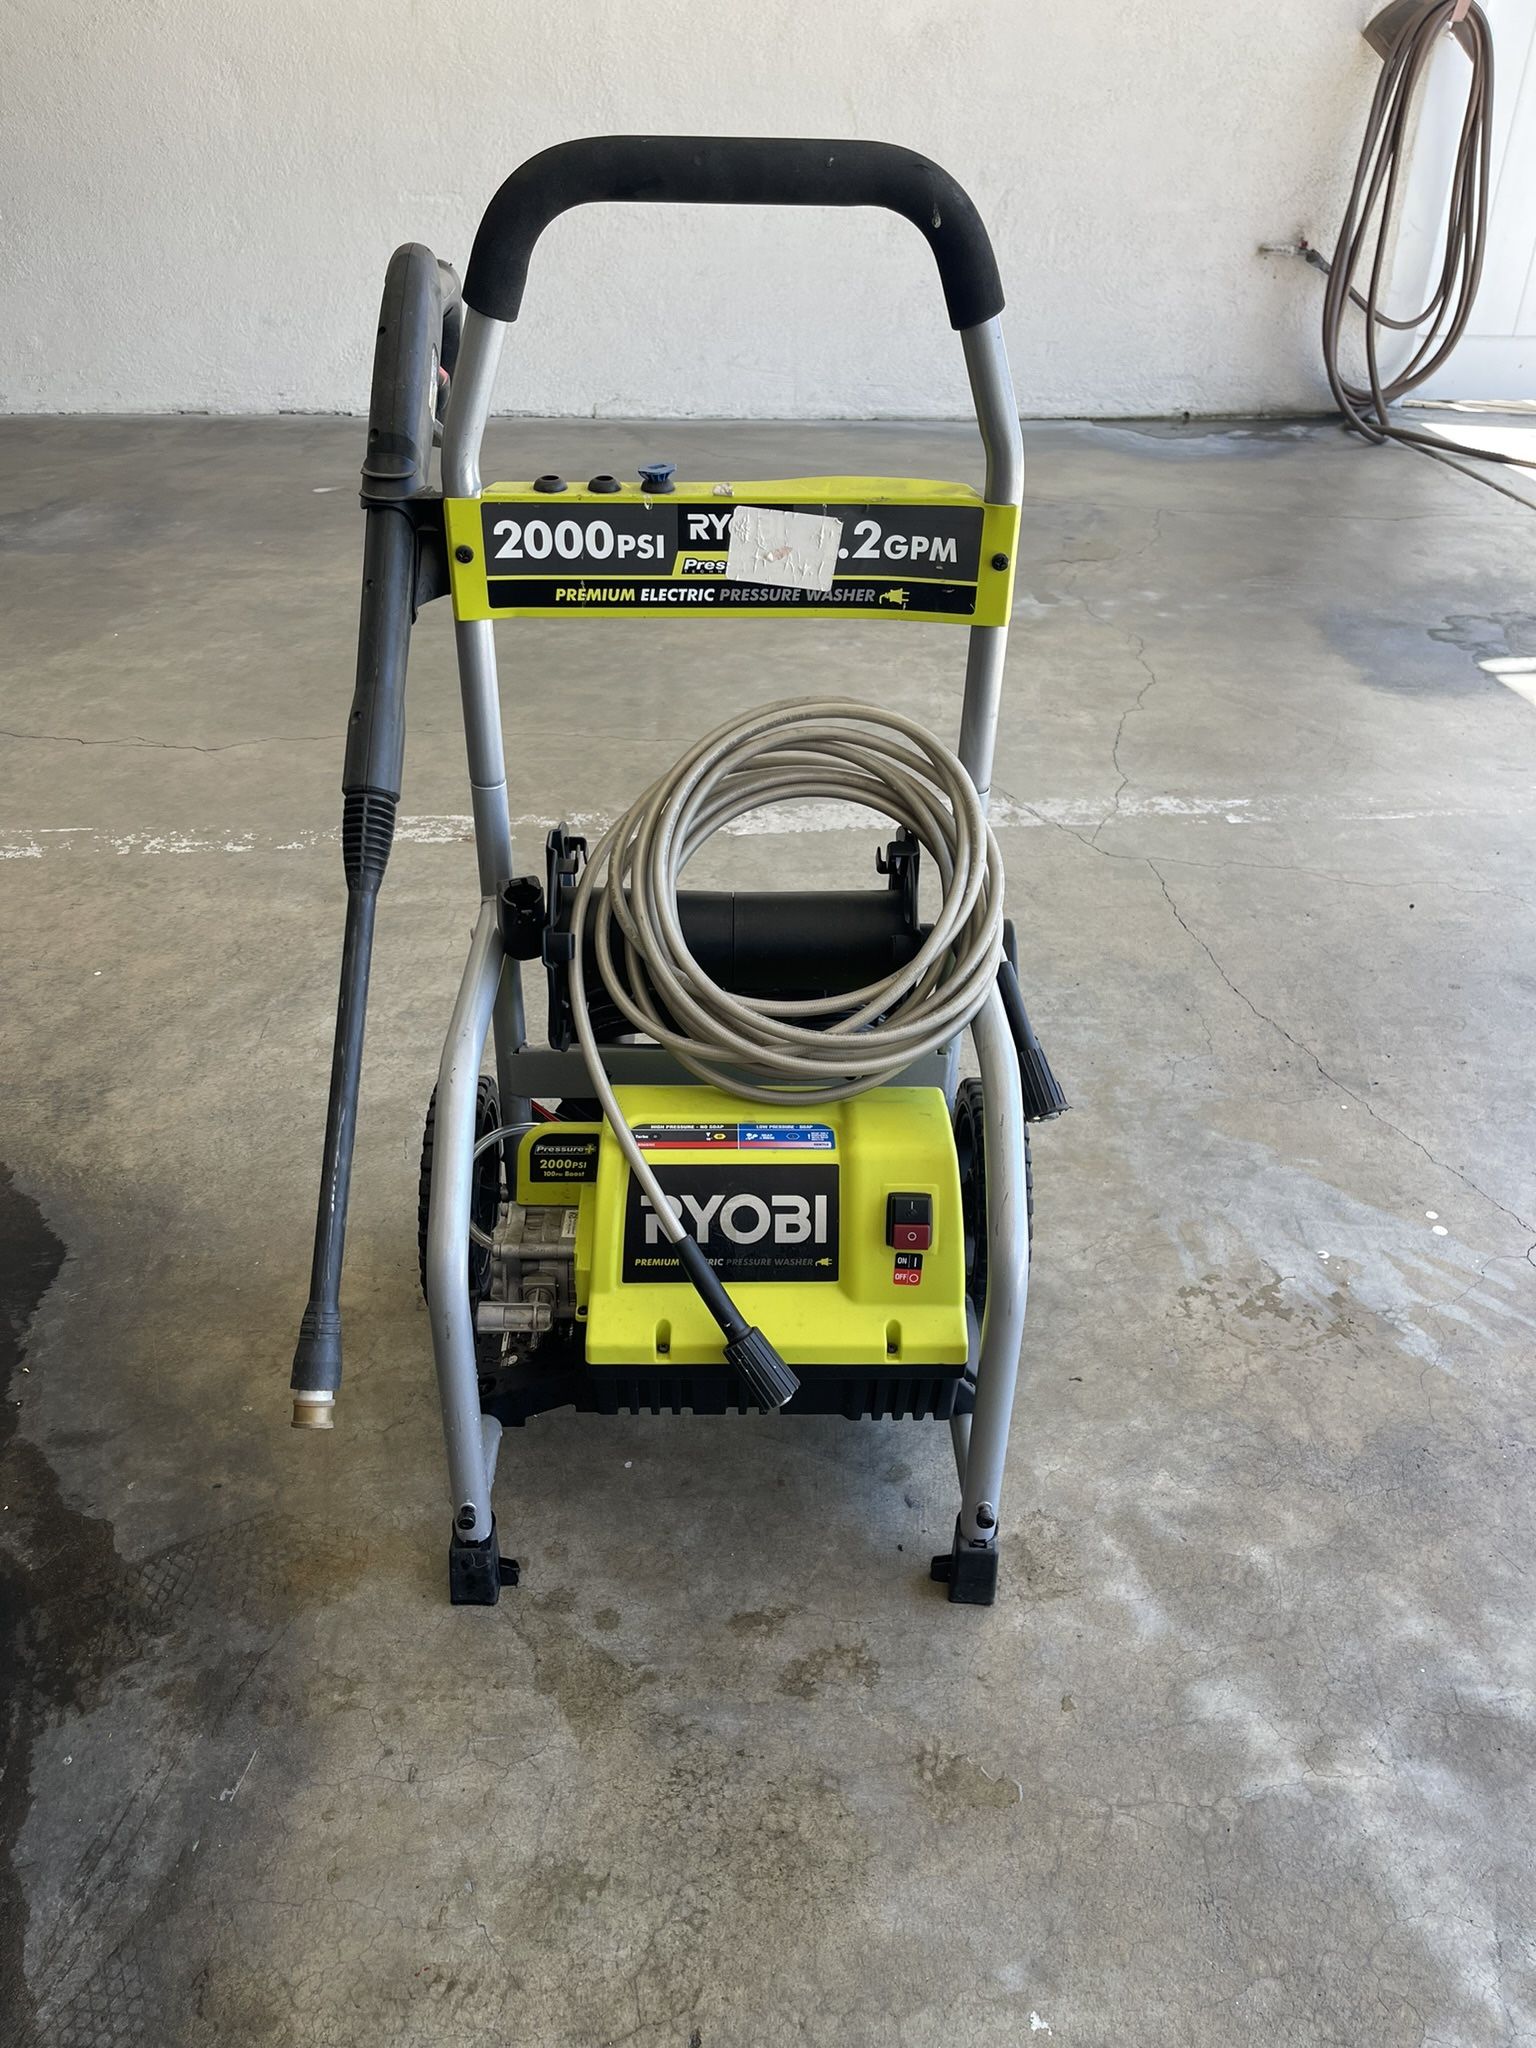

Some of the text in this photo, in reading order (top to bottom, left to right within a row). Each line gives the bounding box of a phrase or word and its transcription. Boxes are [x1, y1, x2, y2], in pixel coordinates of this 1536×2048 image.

[555, 588, 876, 602] PREMIUM ELECTRIC PRESSURE WASHER
[634, 1258, 680, 1267] PREMIUM
[726, 1258, 772, 1266] PRESSURE
[774, 1258, 814, 1266] WASHER
[897, 1256, 908, 1265] ON
